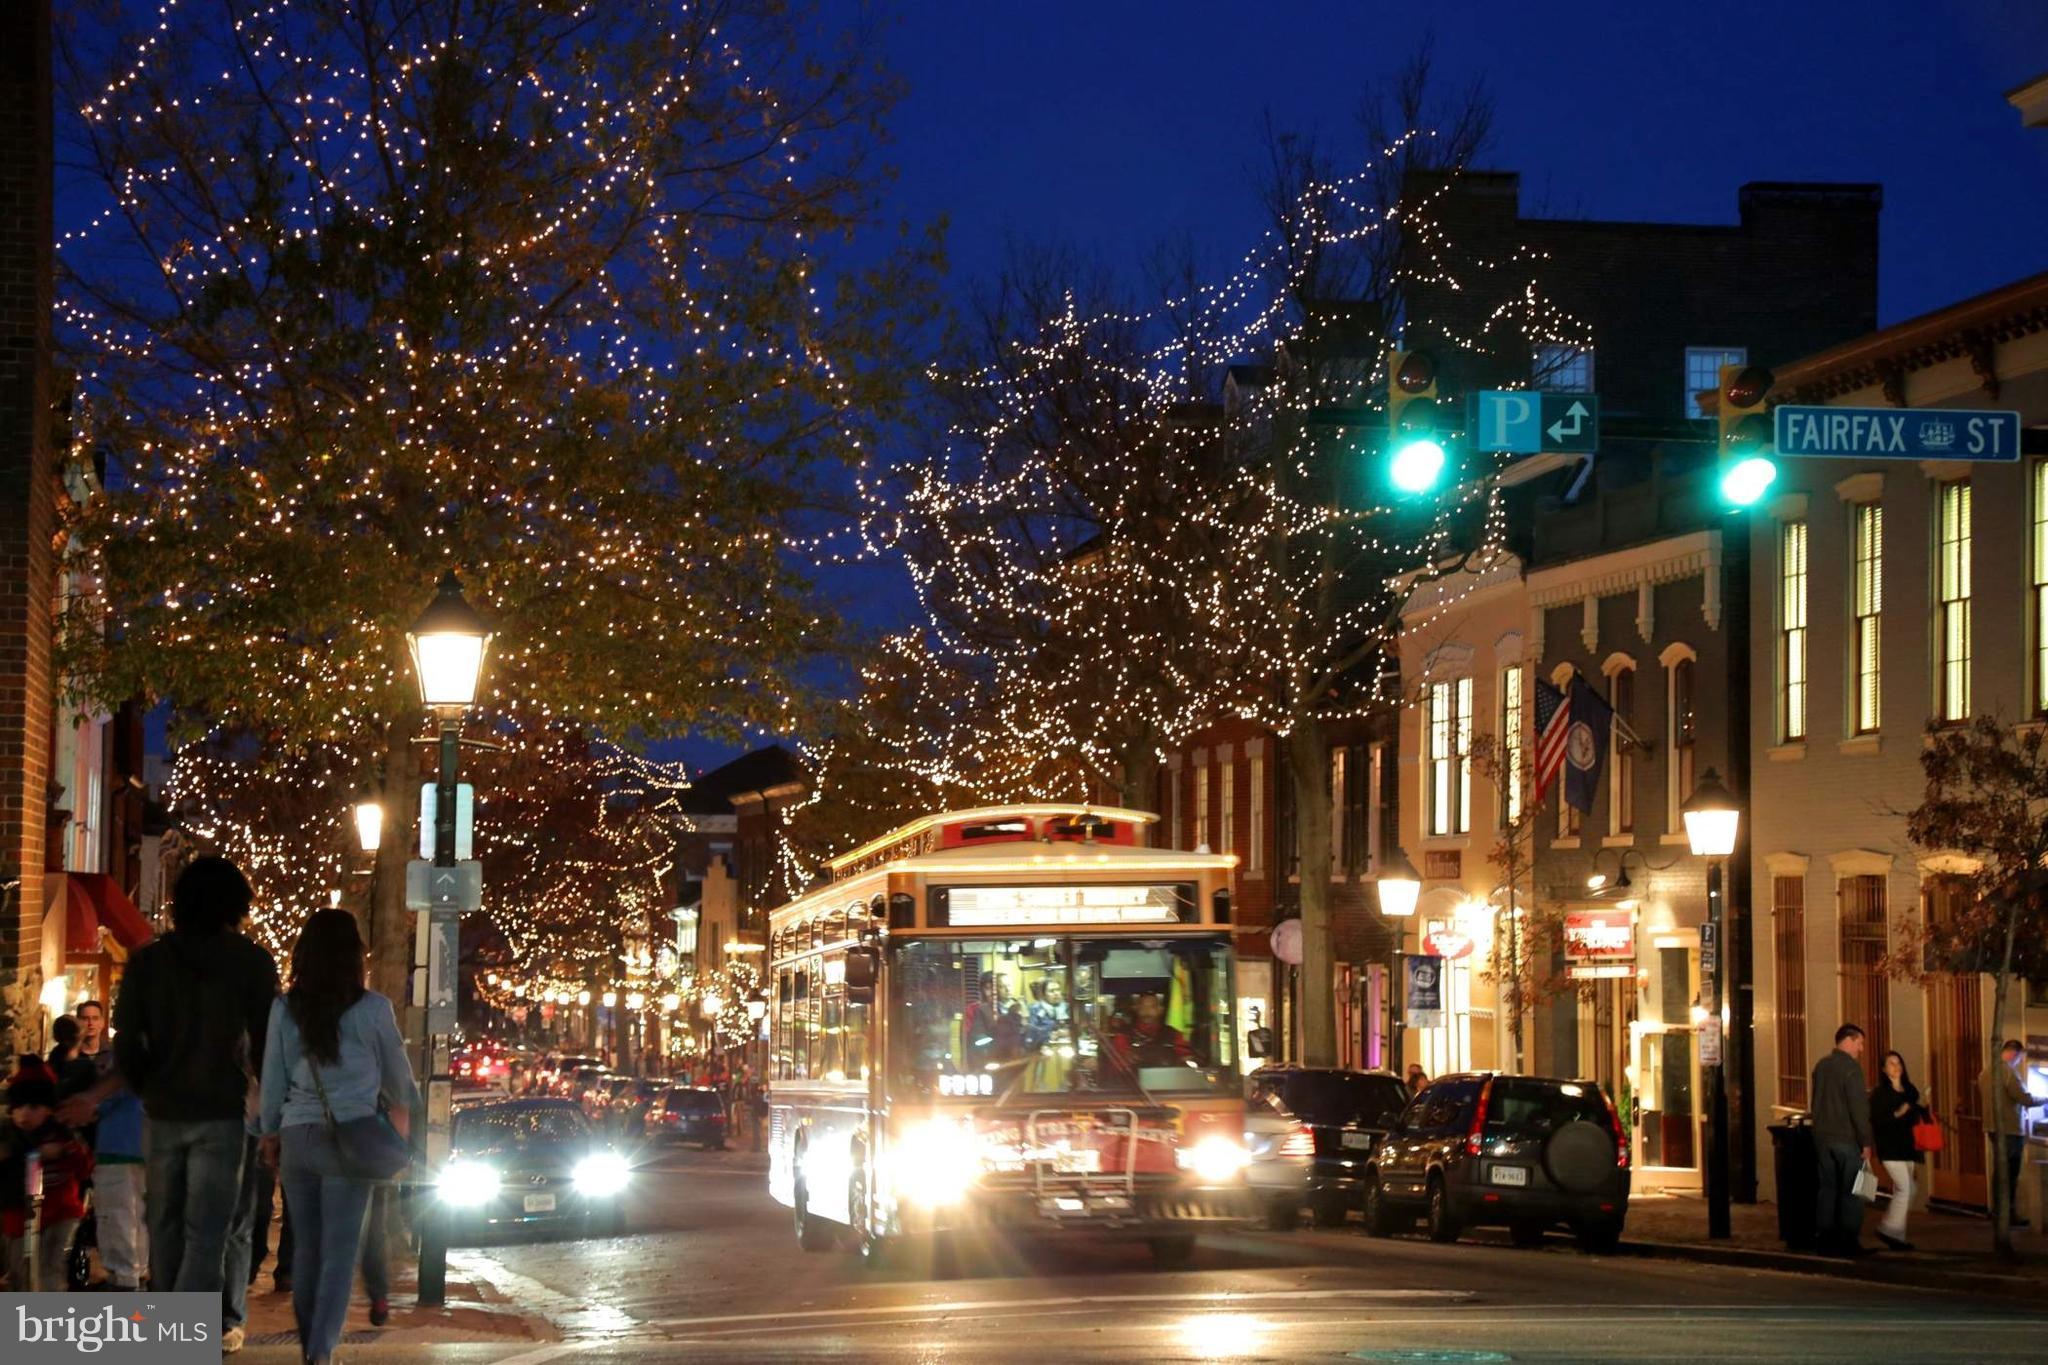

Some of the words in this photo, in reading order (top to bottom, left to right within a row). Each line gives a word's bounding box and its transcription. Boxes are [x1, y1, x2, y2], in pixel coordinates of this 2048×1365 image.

[1490, 397, 1530, 446] P
[1787, 414, 1906, 452] FAIRFAX
[1967, 418, 2004, 454] ST
